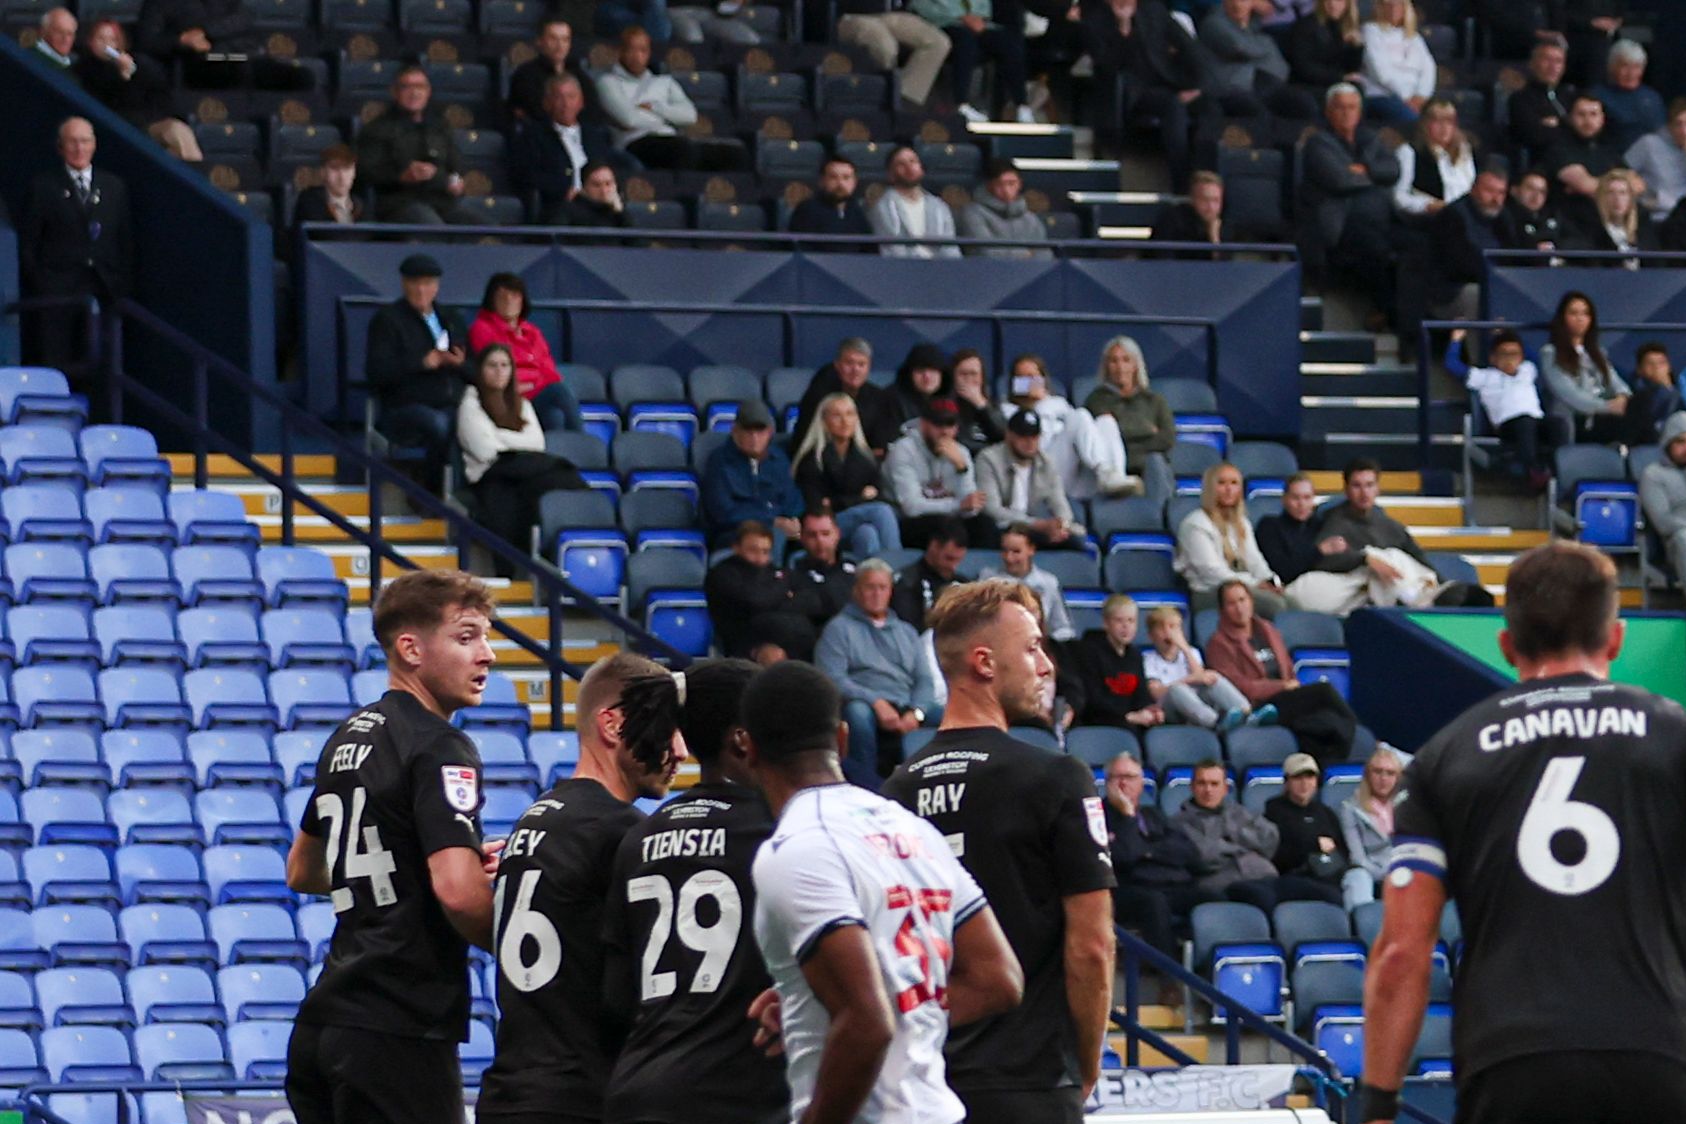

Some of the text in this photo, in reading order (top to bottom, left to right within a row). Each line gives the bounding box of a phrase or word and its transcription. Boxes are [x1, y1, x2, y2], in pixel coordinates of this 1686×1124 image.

[1478, 707, 1648, 752] CANAVAN
[329, 743, 374, 774] FEELY
[917, 782, 967, 817] RAY
[641, 828, 726, 864] TIENSIA
[1517, 756, 1621, 896] 6
[315, 786, 398, 914] 24
[627, 868, 743, 1001] 29
[1085, 1069, 1181, 1109] ERS
